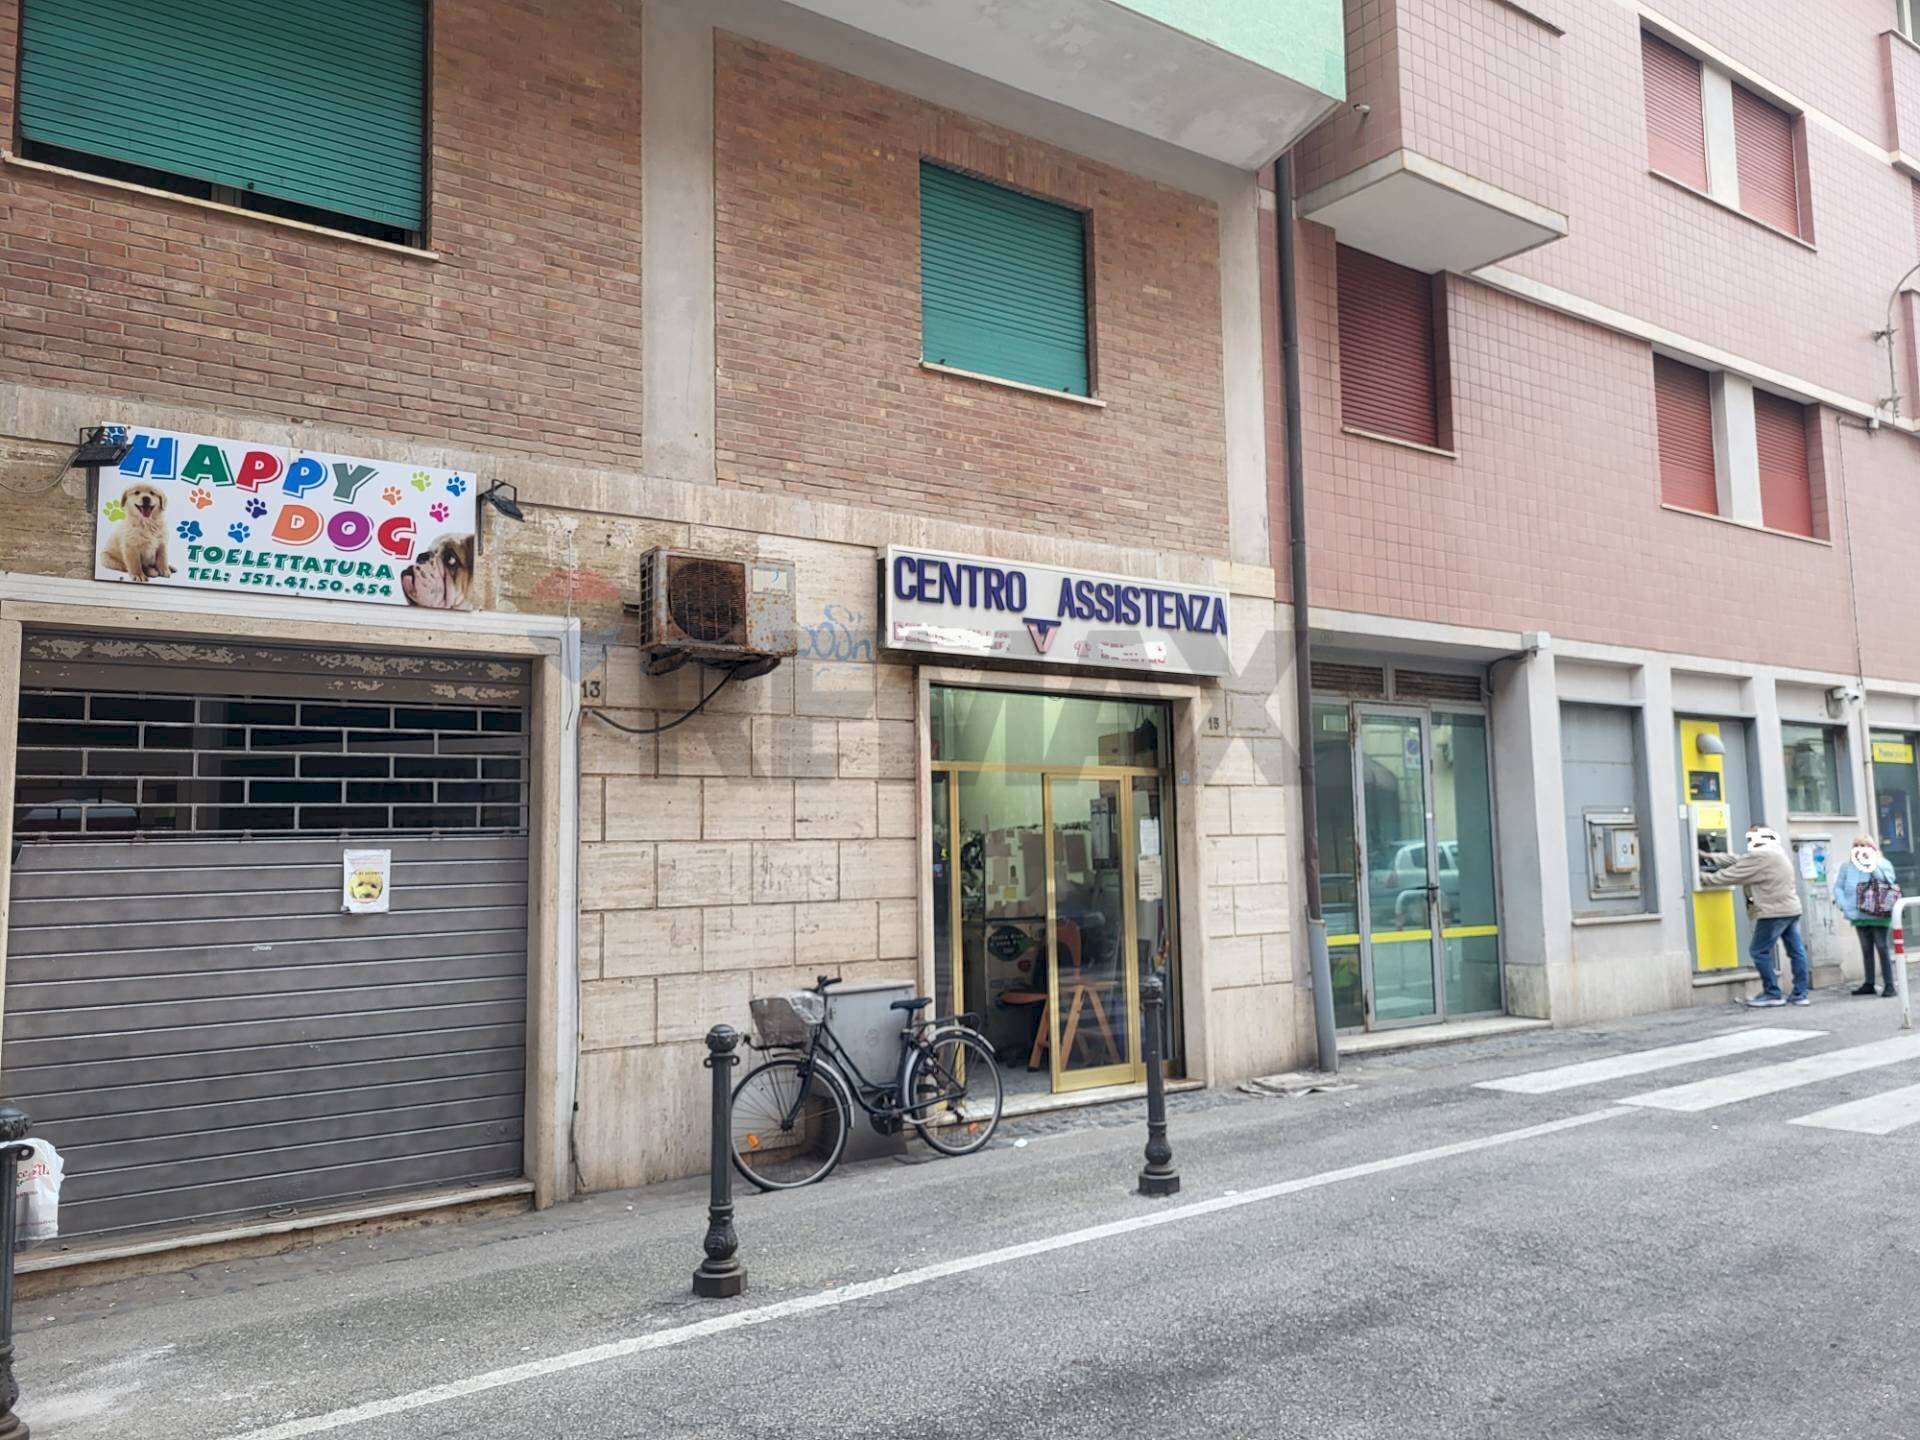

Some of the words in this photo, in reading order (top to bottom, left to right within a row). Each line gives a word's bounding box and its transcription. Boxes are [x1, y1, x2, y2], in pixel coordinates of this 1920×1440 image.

[118, 433, 380, 504] HAPPY
[271, 503, 417, 560] DOG
[187, 544, 395, 580] TOELETTATURA
[187, 567, 231, 582] TEL:
[239, 571, 392, 597] 351.41.50.454
[893, 555, 1027, 613] CENTRO
[1058, 577, 1228, 636] ASSISTENZA
[580, 680, 601, 698] 13
[1208, 716, 1220, 730] 15
